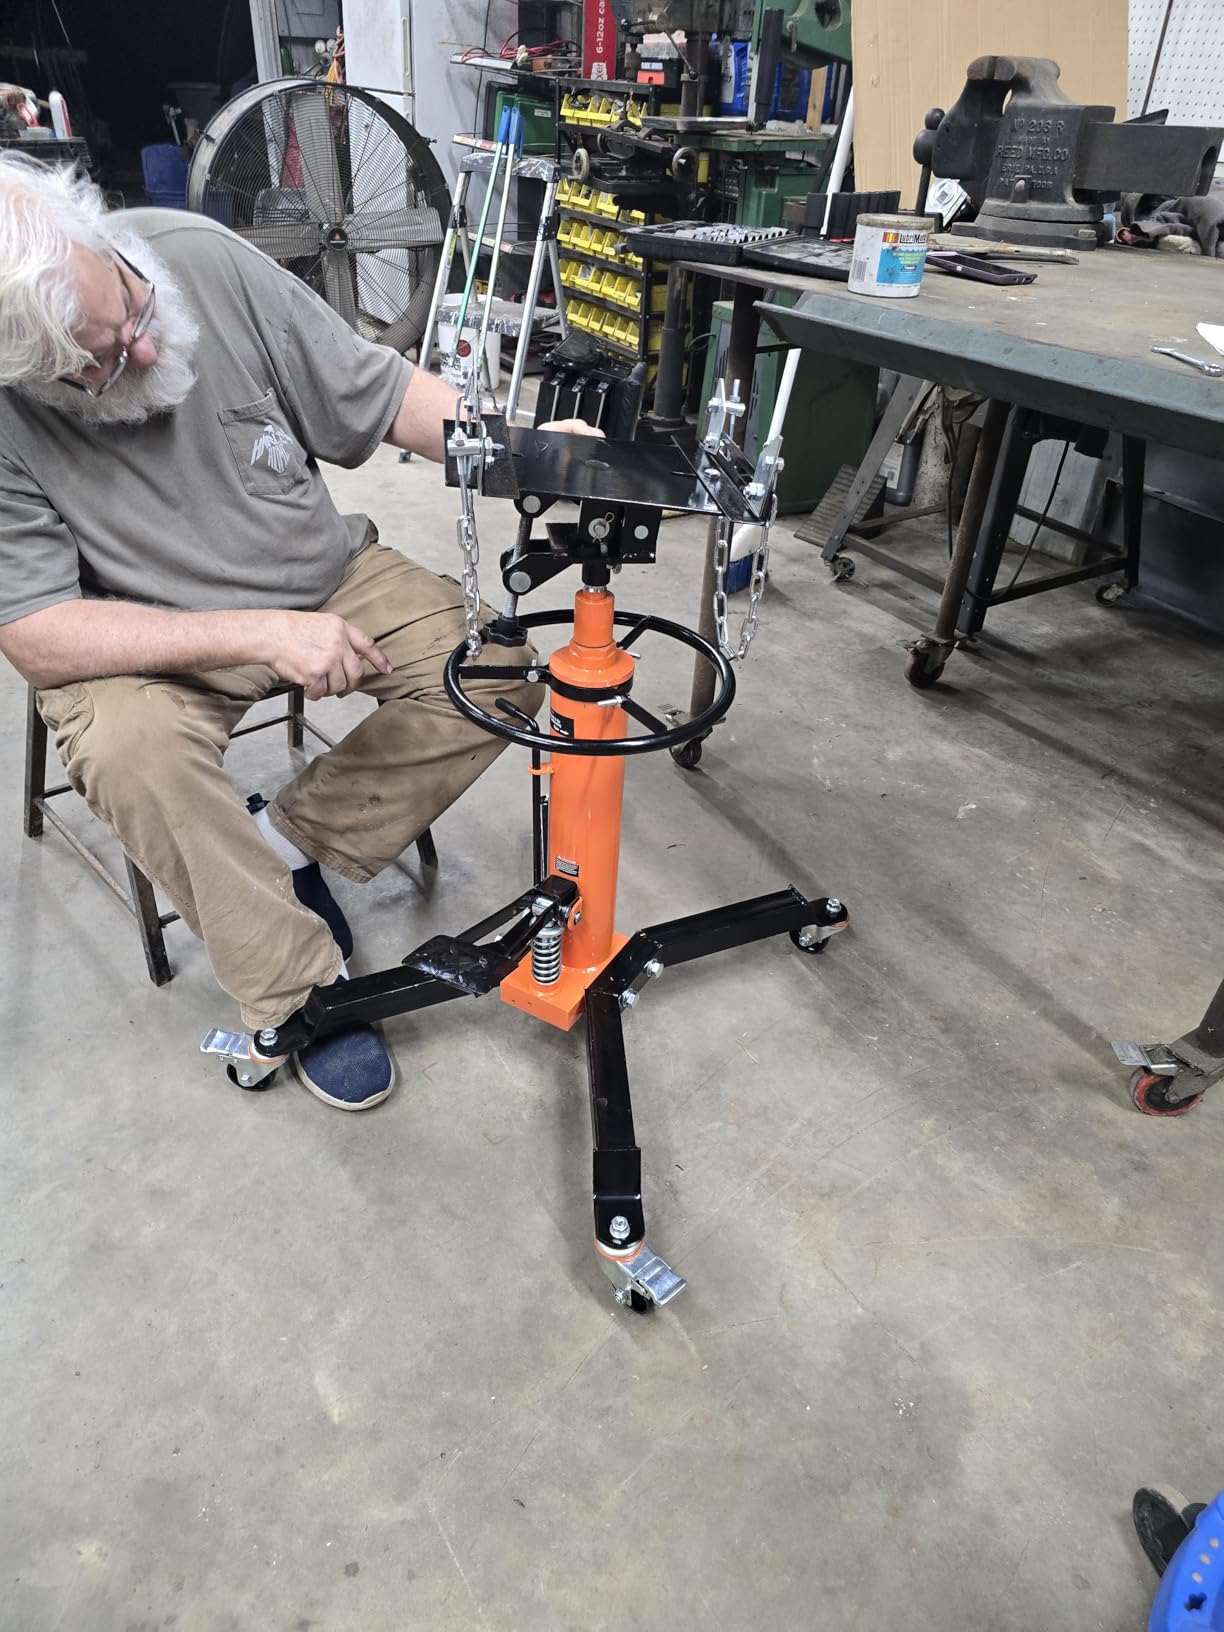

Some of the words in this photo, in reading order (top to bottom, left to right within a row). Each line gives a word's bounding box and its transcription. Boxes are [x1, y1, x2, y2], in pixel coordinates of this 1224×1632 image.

[596, 17, 605, 54] 6-12oz
[1027, 119, 1053, 134] 206
[997, 145, 1024, 159] REED
